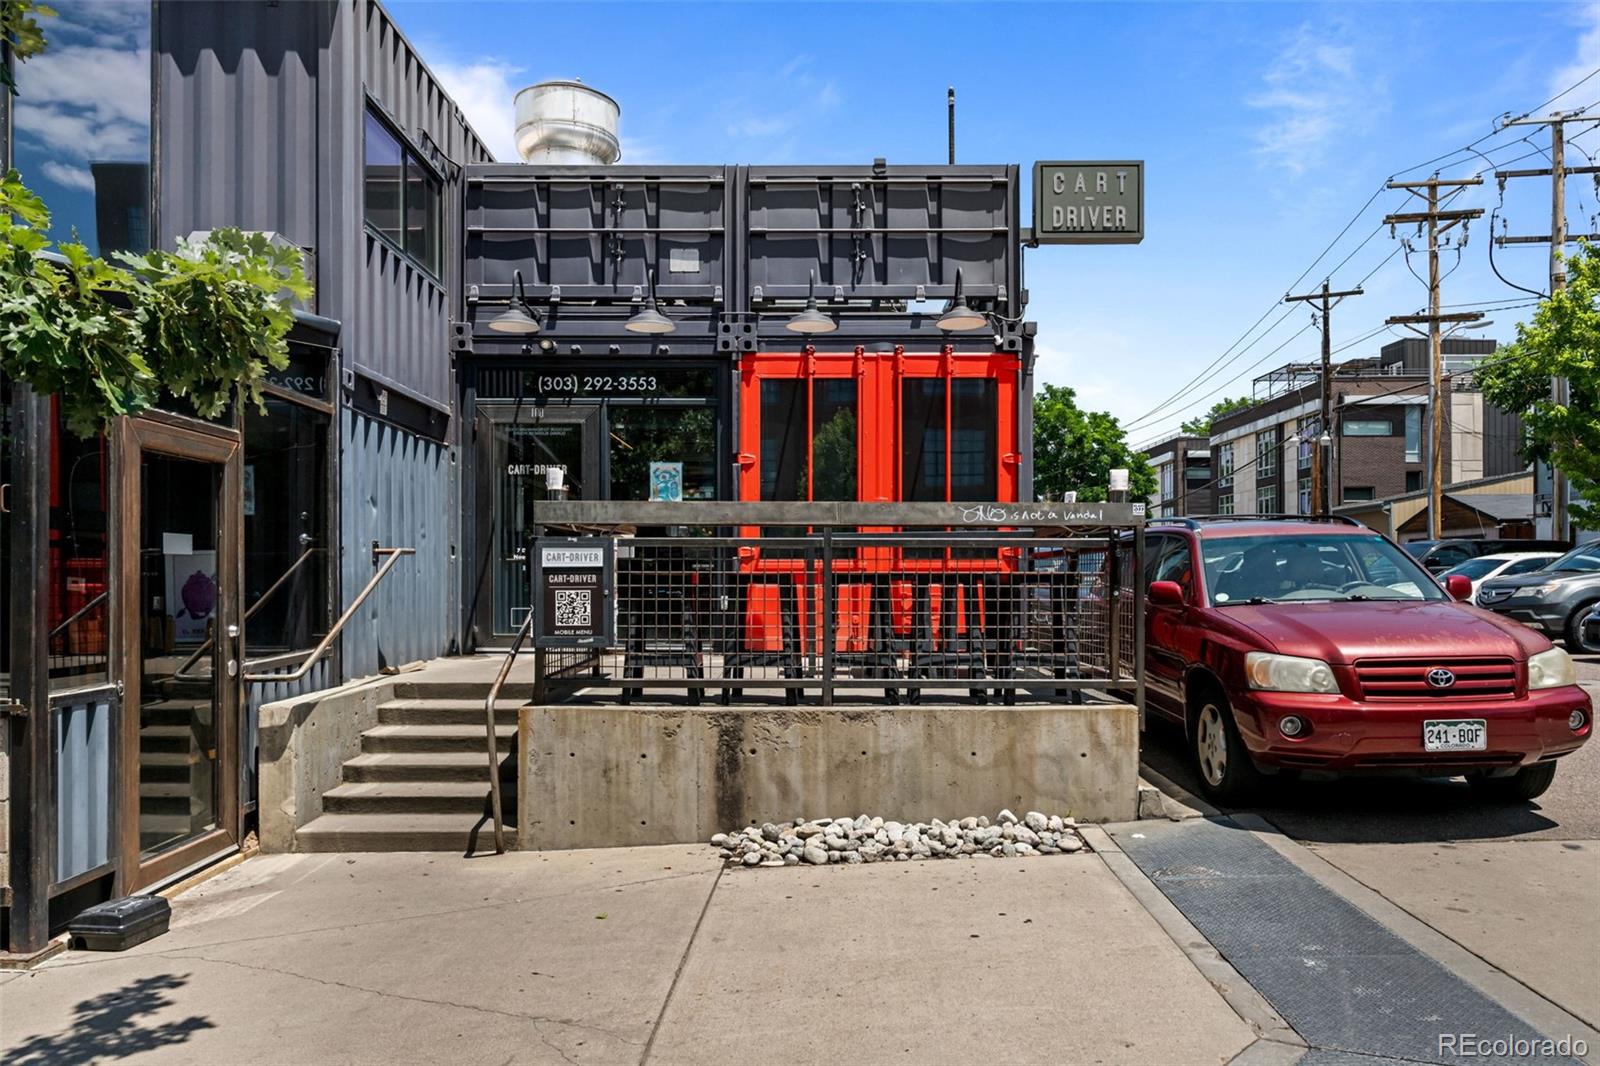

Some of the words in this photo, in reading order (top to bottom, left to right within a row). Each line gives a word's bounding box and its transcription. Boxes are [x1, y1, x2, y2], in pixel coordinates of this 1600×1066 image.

[1053, 171, 1127, 195] CART
[1052, 206, 1127, 229] DRIVER
[538, 376, 578, 393] (303)
[583, 376, 657, 391] 292-3553
[508, 464, 568, 475] CART-DRR
[1021, 511, 1045, 521] not
[1047, 511, 1059, 519] a
[546, 552, 599, 562] CART-DRIVER
[548, 574, 597, 583] CART-DRIVER
